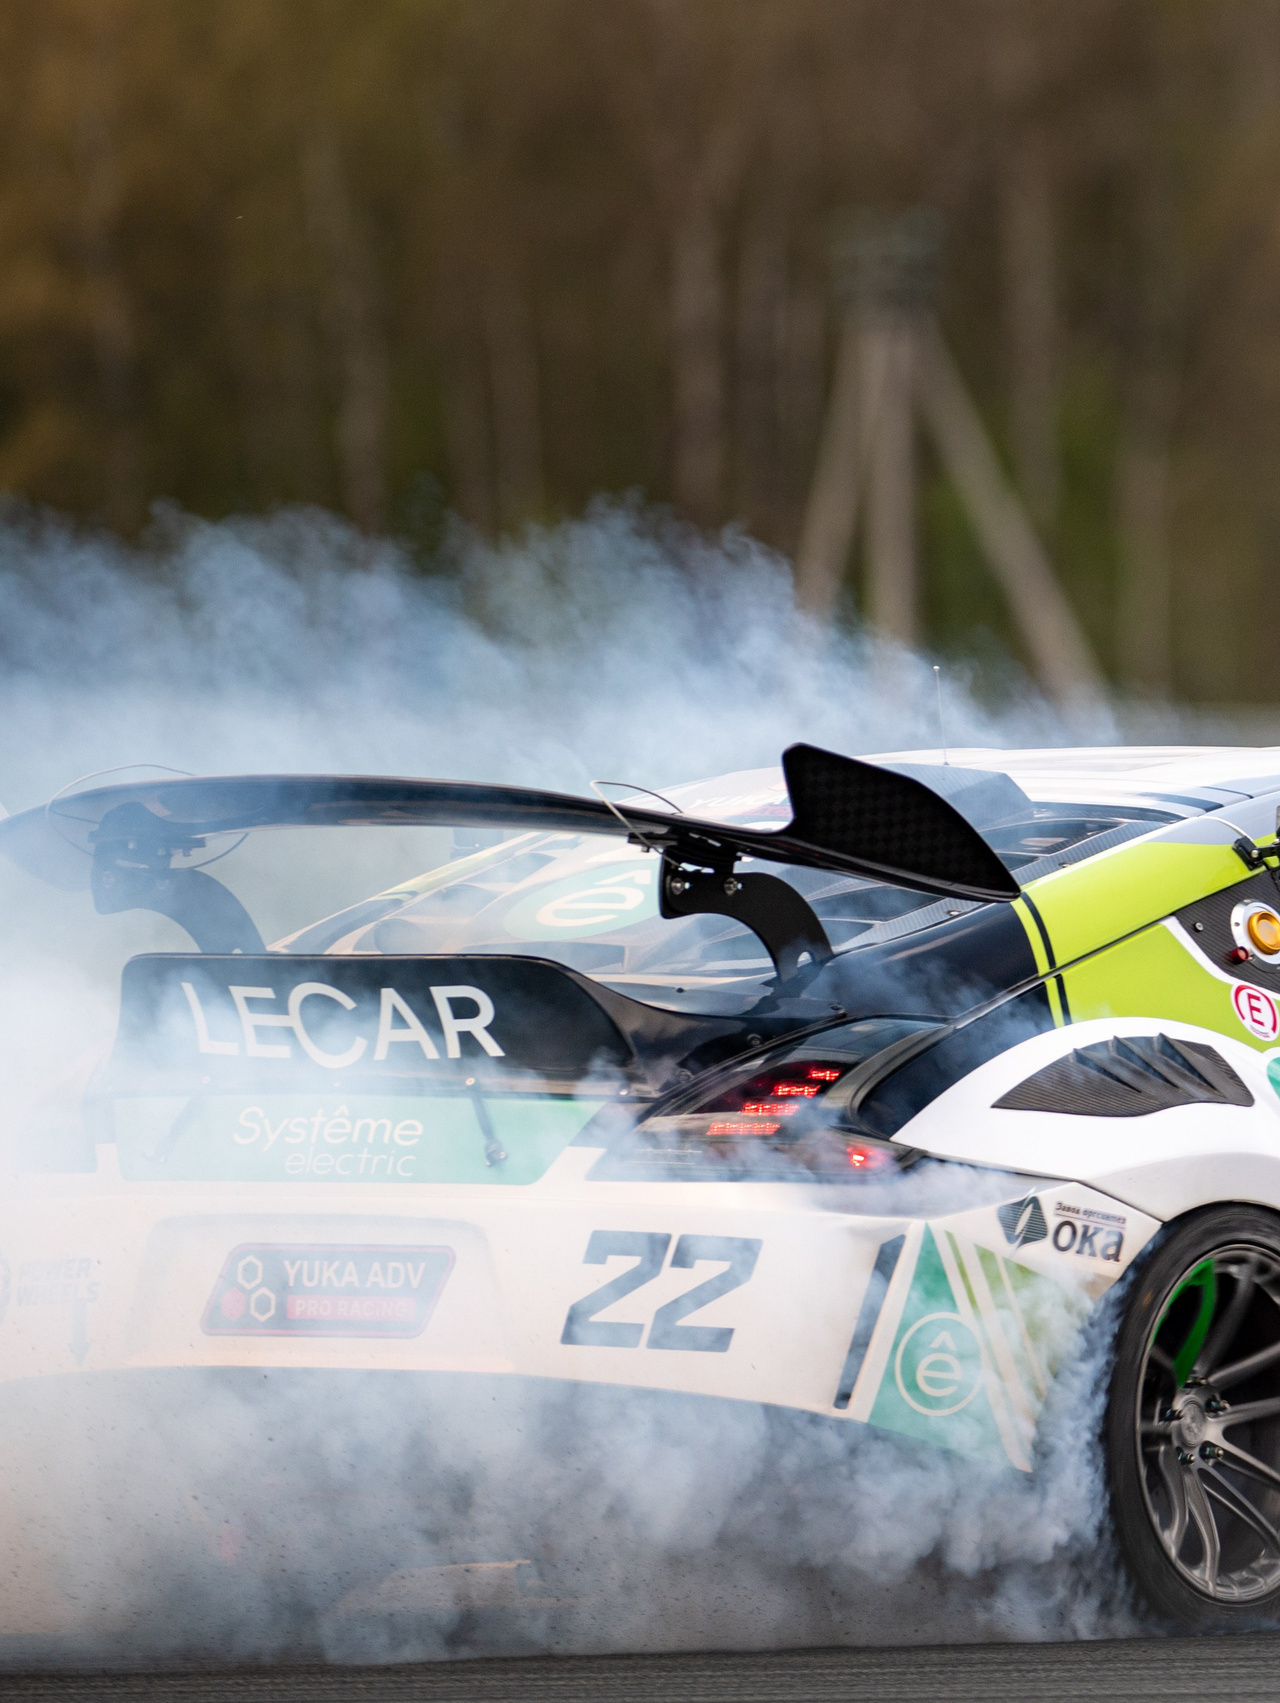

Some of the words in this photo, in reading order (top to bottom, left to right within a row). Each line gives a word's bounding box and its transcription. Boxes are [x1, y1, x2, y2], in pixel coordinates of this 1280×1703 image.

[181, 981, 505, 1068] LECAR
[231, 1105, 424, 1151] Systême
[283, 1143, 418, 1177] electric
[283, 1259, 360, 1288] YUKA
[365, 1261, 427, 1289] ADV
[560, 1229, 763, 1353] 22
[294, 1299, 333, 1317] PRO
